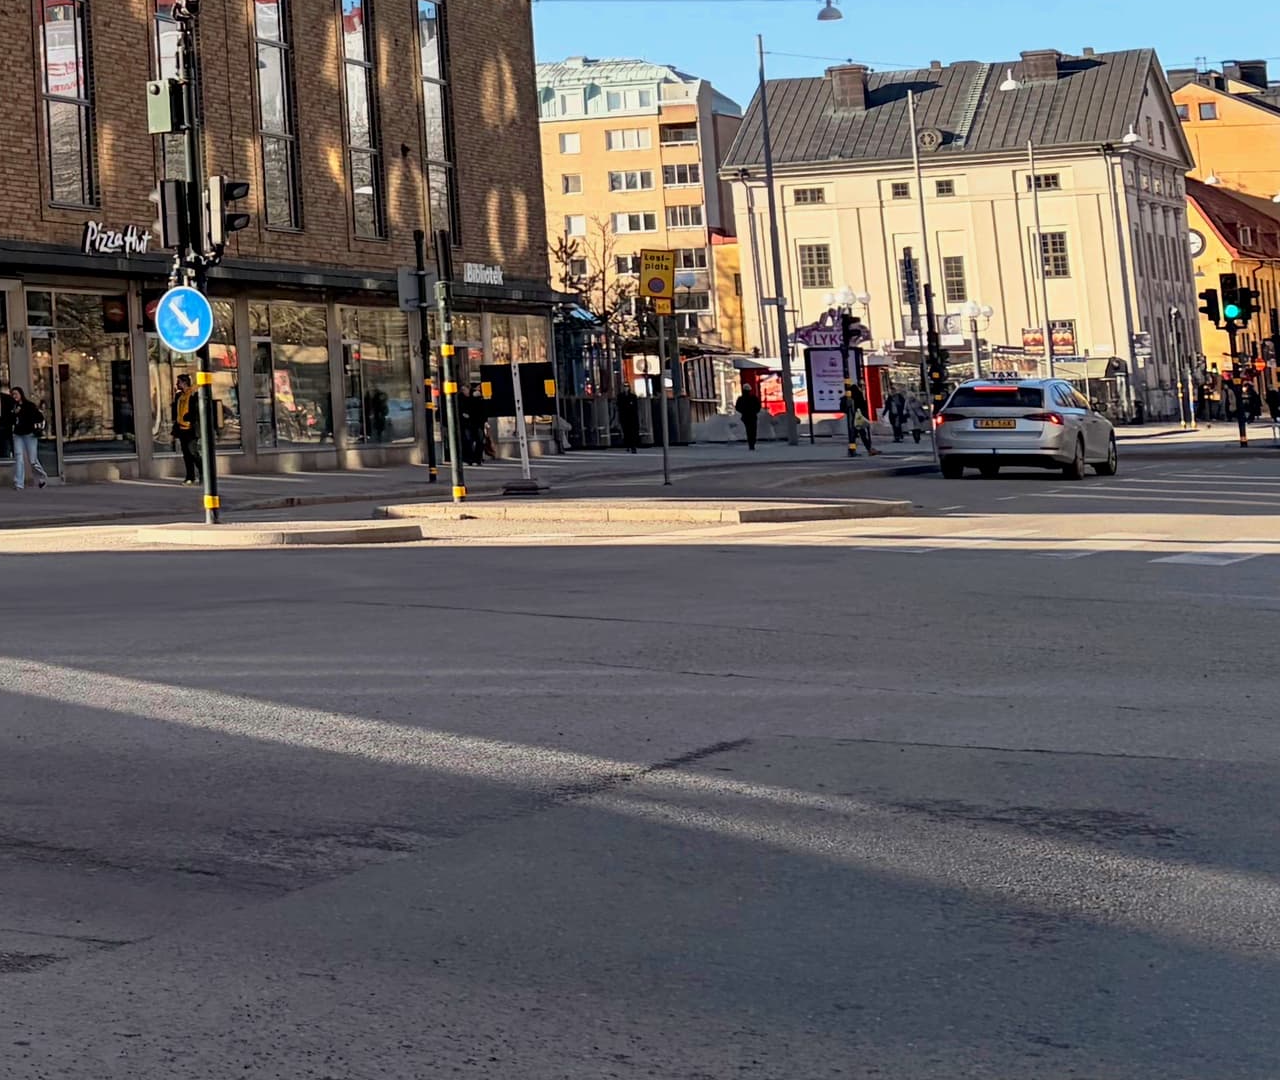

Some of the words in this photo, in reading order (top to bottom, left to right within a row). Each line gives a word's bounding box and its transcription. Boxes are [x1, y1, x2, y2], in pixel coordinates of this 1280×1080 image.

[86, 220, 124, 255] Pizza
[124, 224, 153, 259] Hut
[813, 333, 844, 346] LYK
